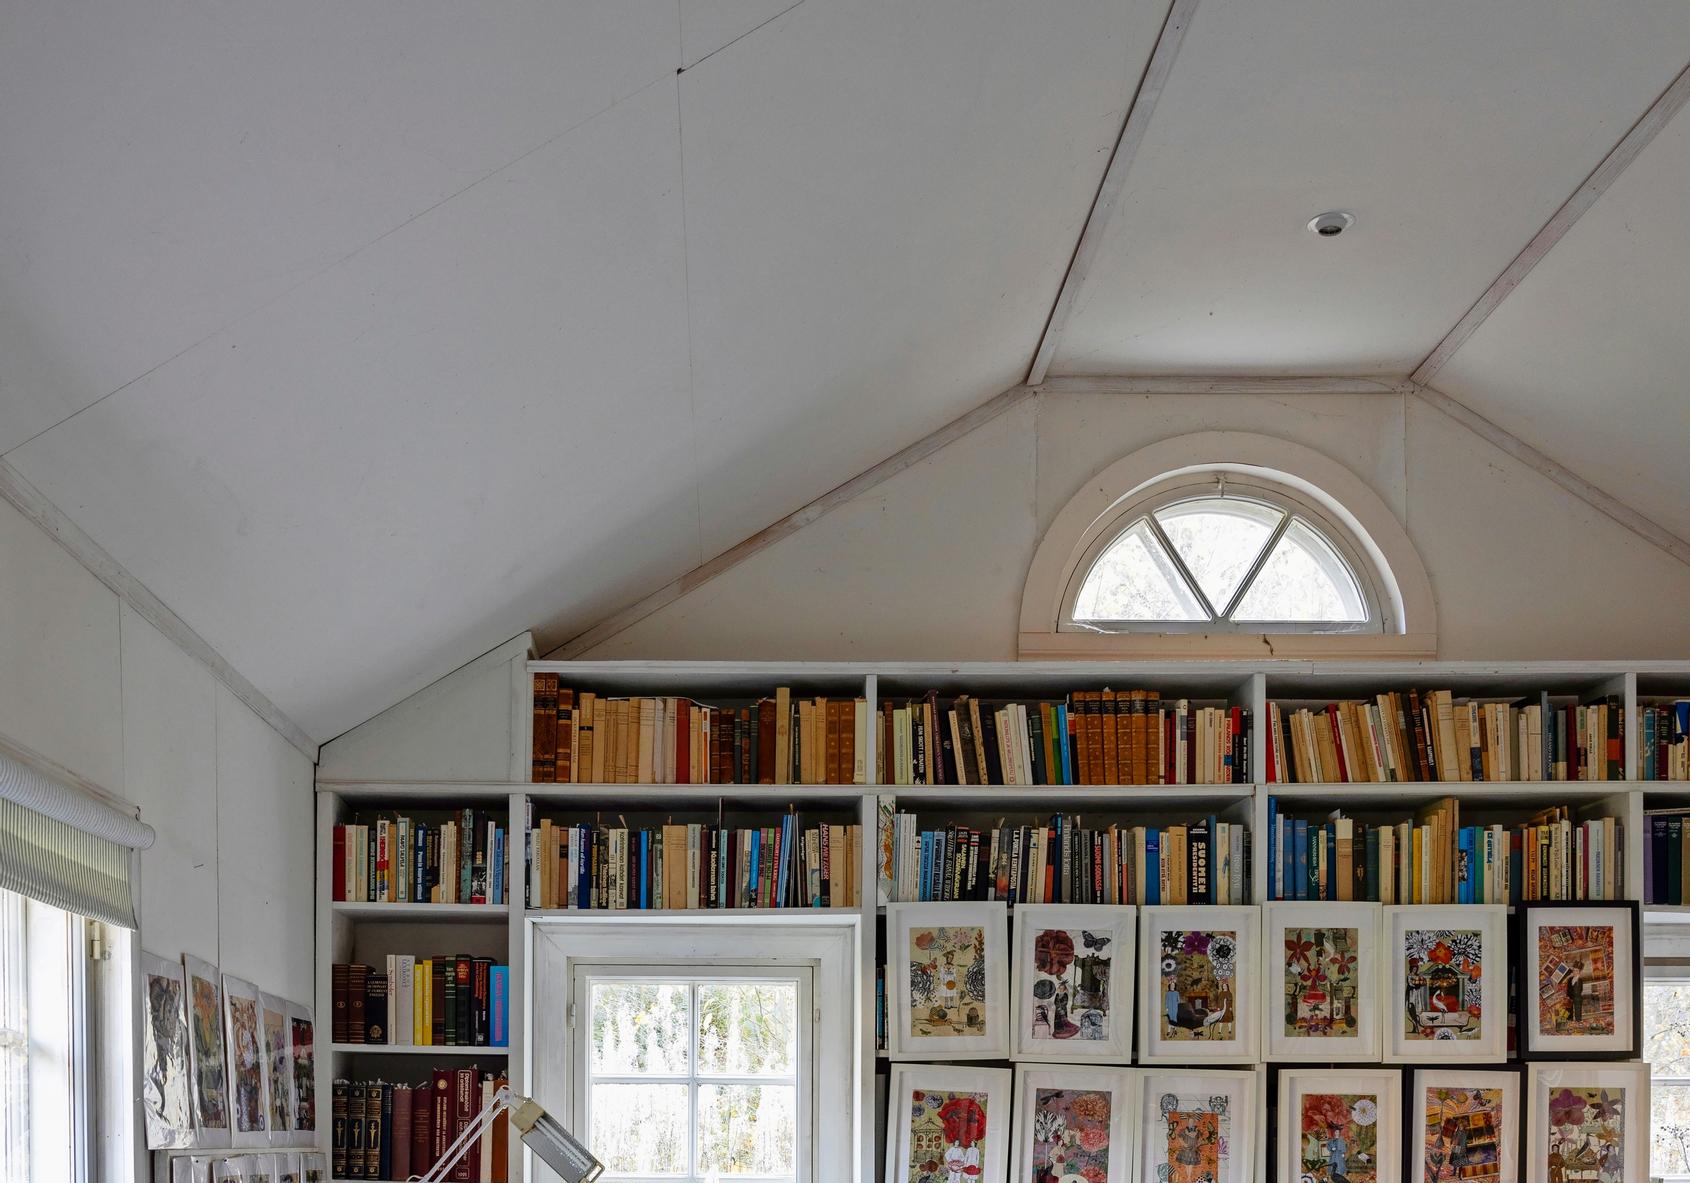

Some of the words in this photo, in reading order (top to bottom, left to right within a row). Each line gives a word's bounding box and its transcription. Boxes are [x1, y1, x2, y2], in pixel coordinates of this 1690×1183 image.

[822, 824, 830, 846] HANS
[822, 846, 830, 880] METZGER
[1198, 842, 1206, 893] SUOMEN
